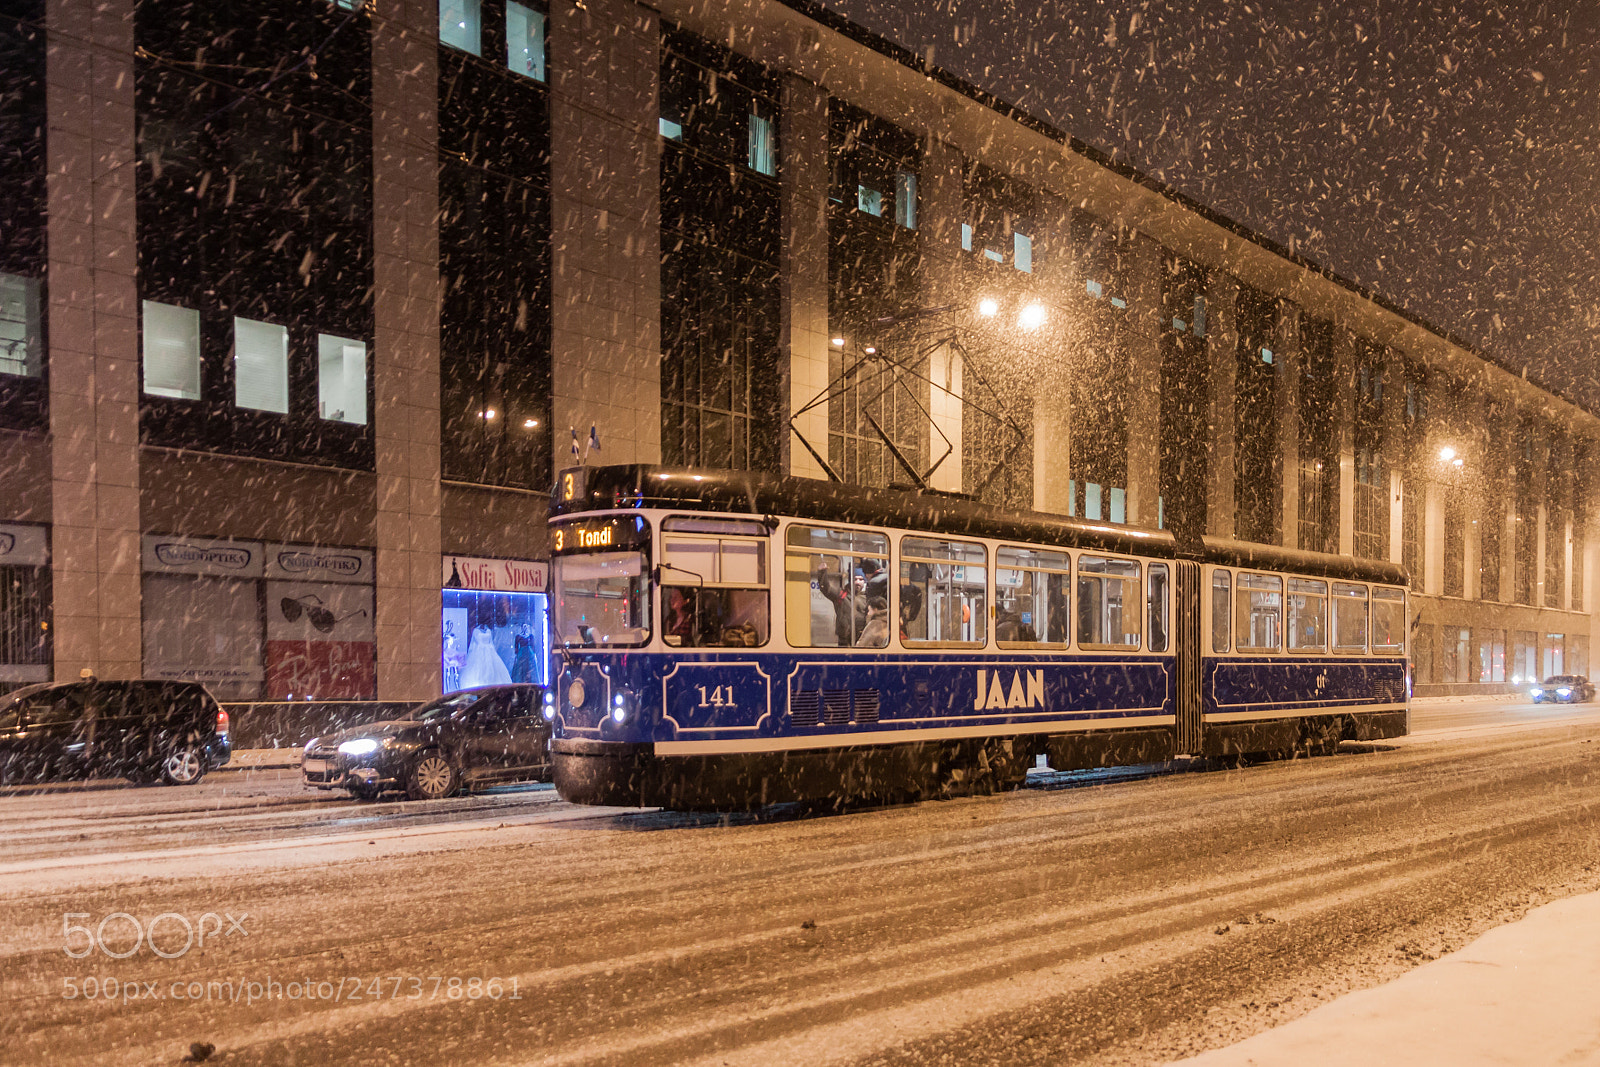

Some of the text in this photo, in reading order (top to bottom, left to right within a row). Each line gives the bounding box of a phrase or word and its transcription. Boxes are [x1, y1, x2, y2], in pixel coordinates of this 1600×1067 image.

[564, 473, 574, 501] 3
[555, 526, 612, 552] 3 Tondi
[461, 561, 542, 589] Sofia Sposa
[697, 685, 736, 709] 141
[974, 669, 1045, 711] JAAN
